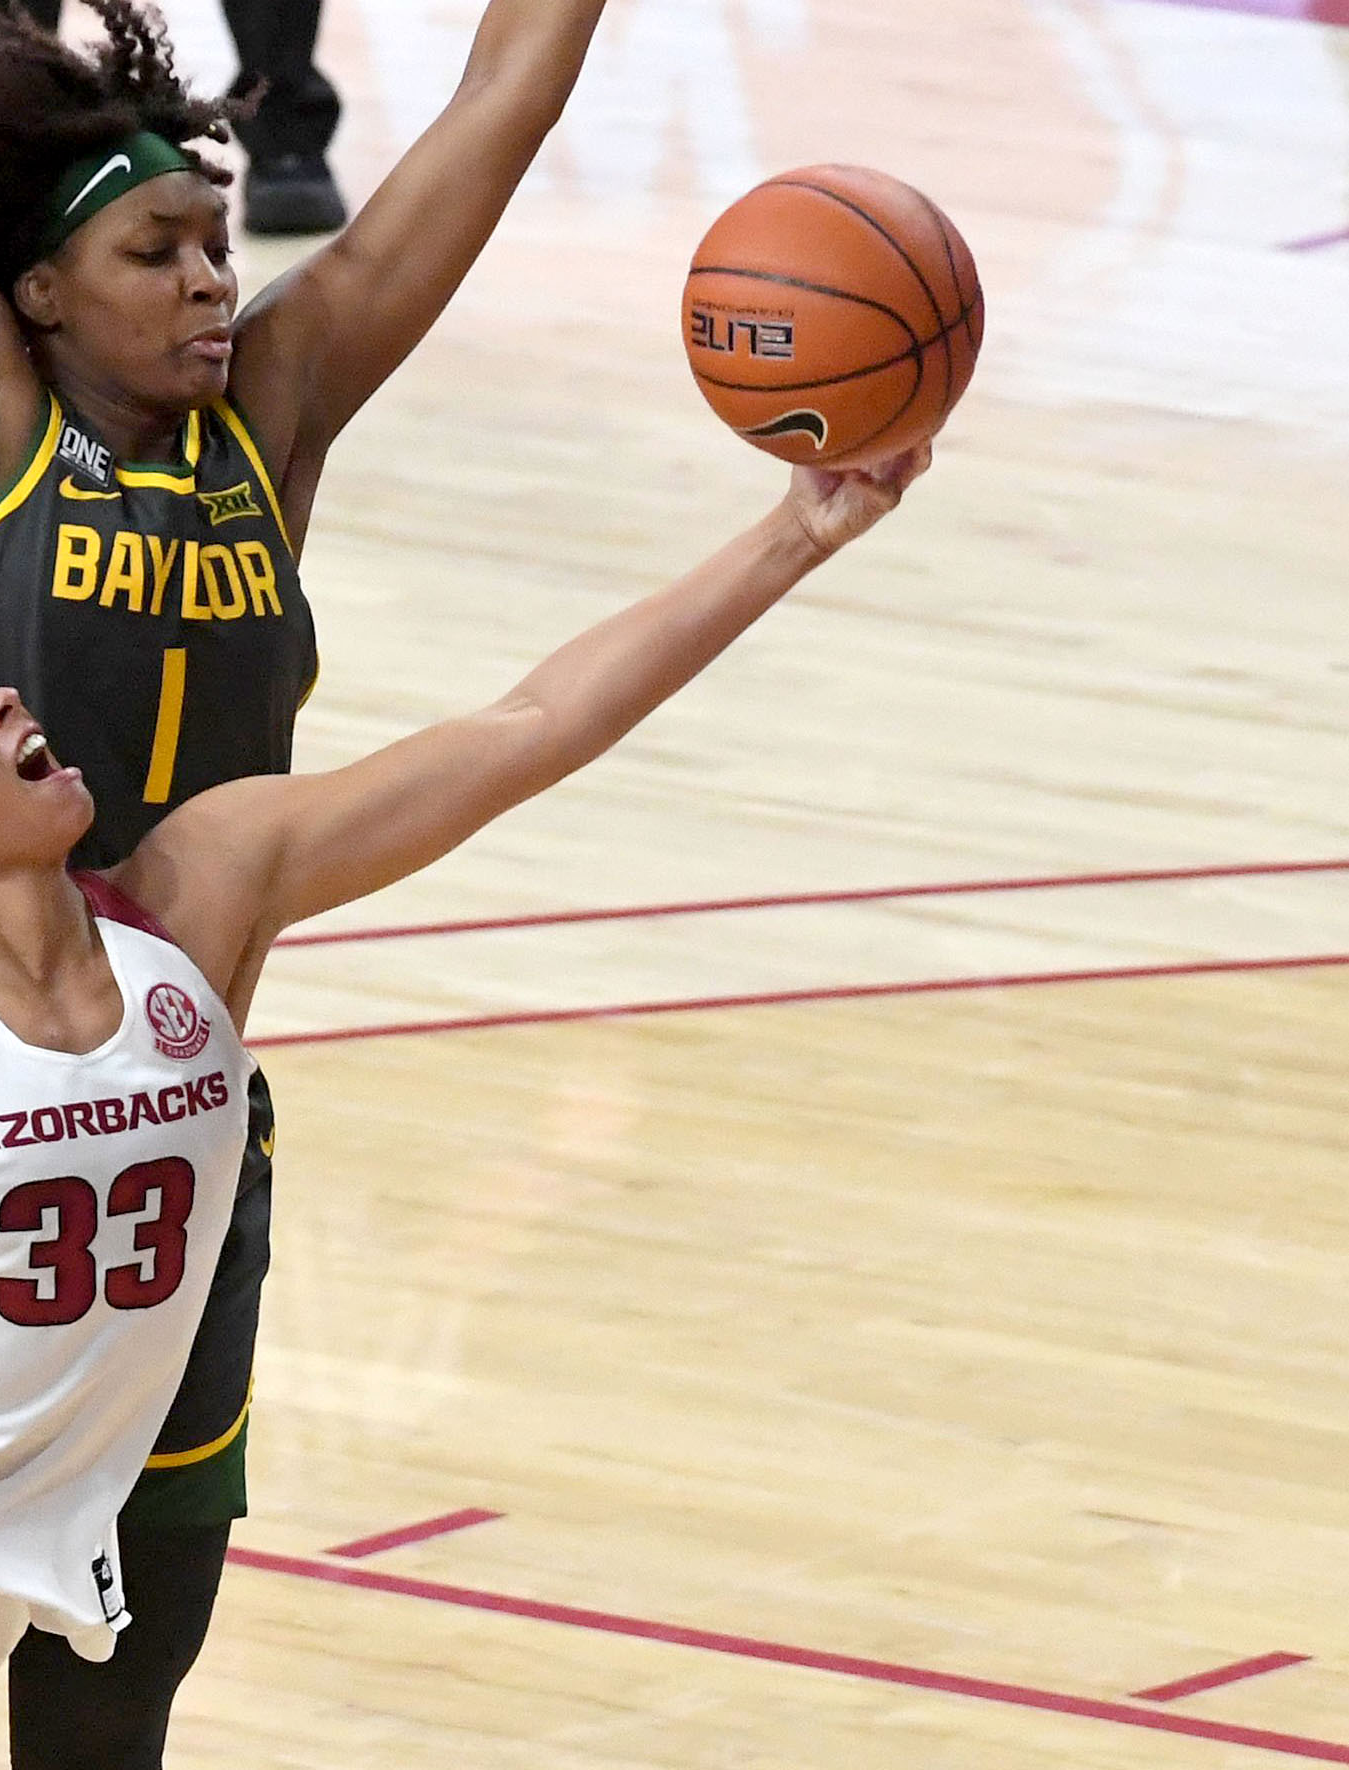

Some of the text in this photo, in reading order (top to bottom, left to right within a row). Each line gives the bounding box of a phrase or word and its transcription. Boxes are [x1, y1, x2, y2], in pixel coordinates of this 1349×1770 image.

[691, 309, 794, 361] ELITE
[59, 426, 112, 482] ONE
[52, 522, 284, 622] BAYLOR
[142, 647, 187, 804] 1
